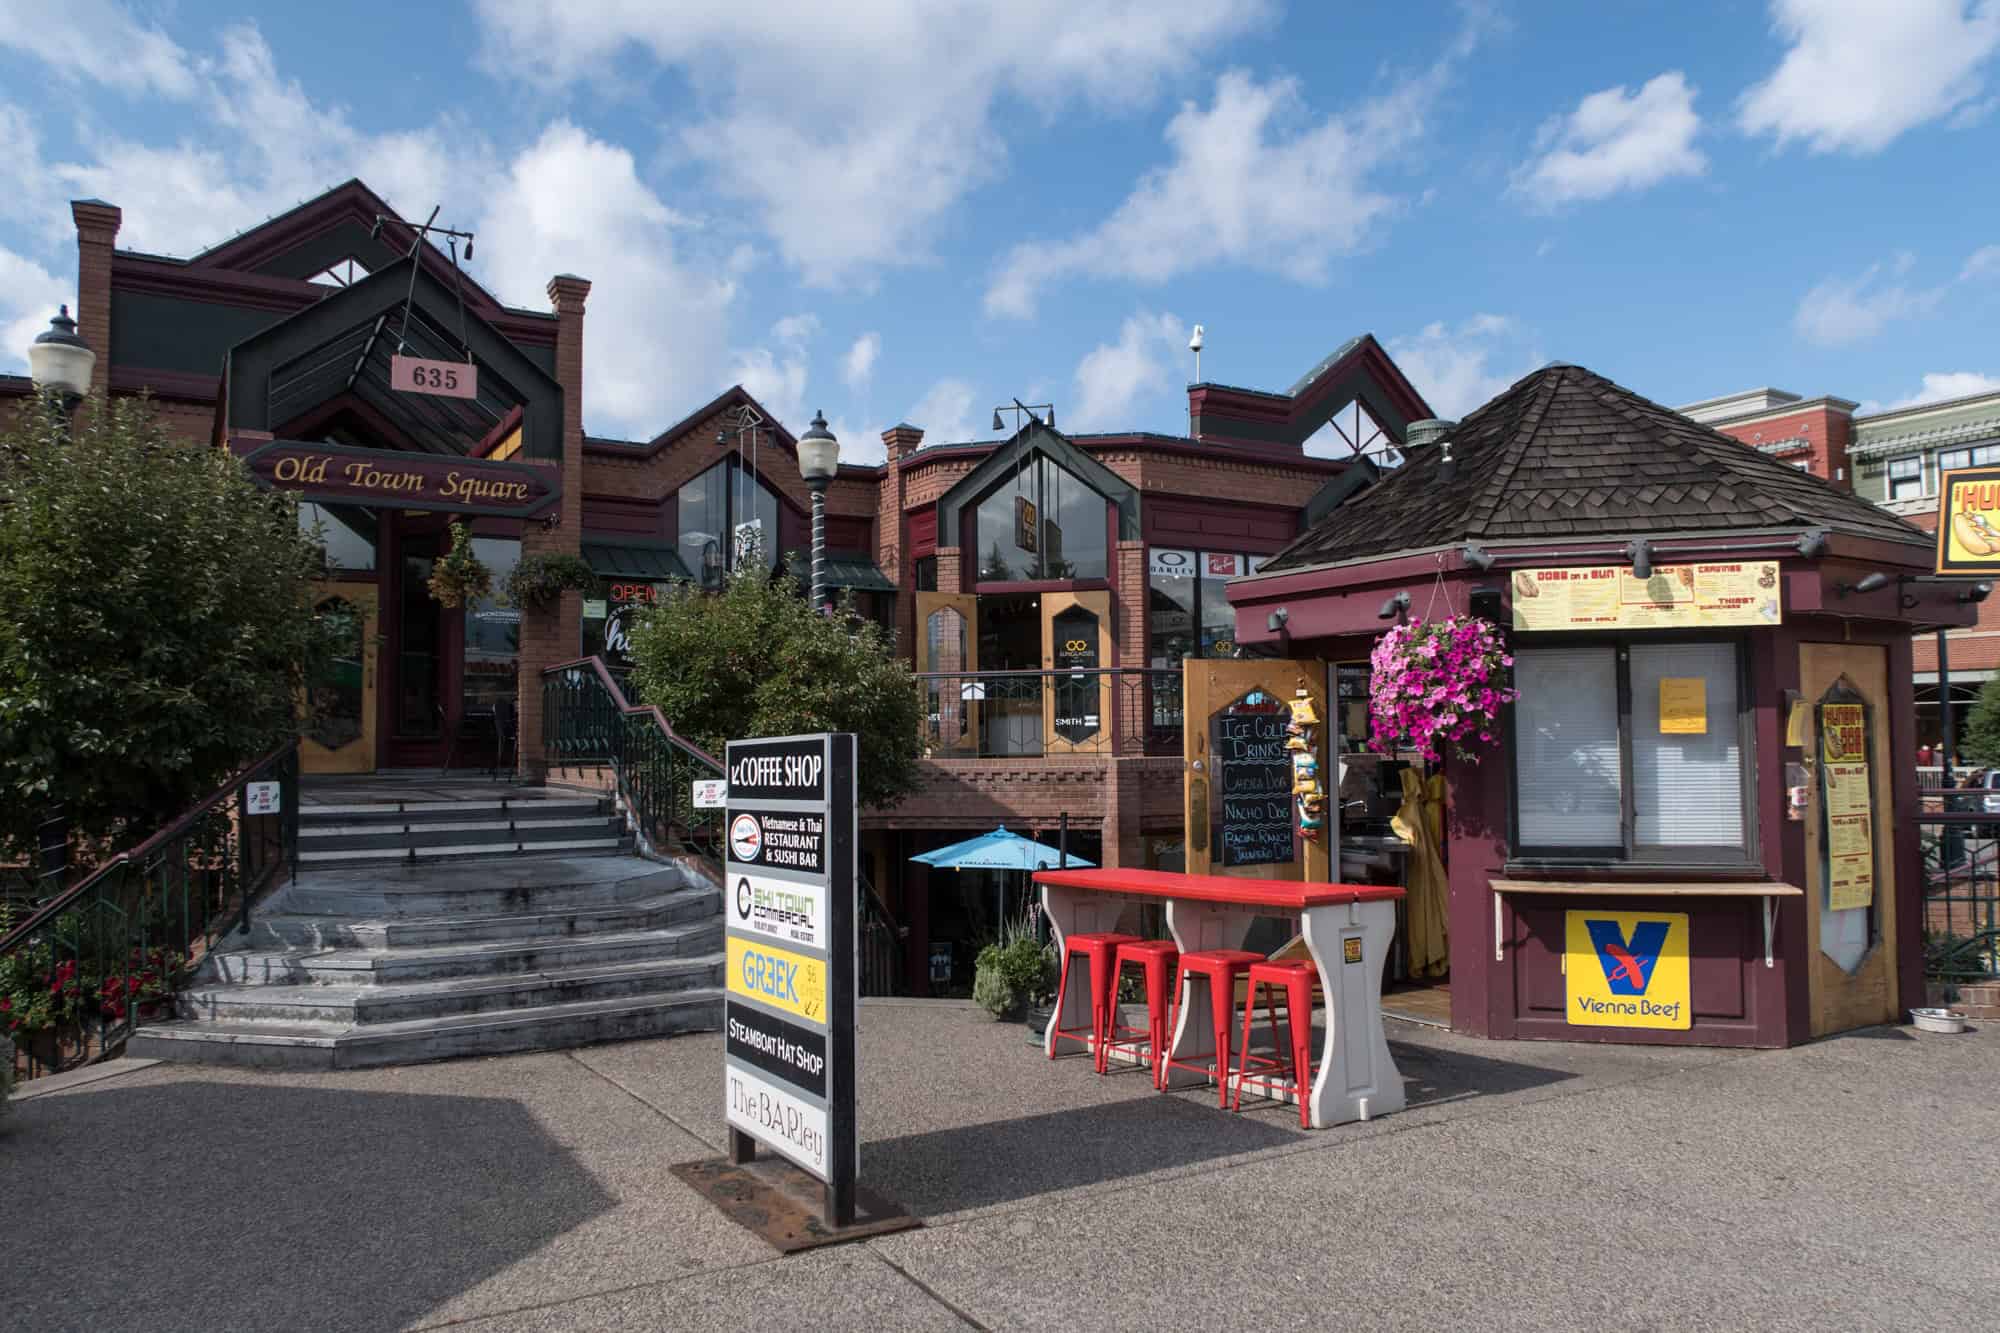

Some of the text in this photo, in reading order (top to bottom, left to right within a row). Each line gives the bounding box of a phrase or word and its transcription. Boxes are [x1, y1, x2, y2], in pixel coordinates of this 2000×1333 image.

[412, 366, 458, 390] 635
[274, 454, 530, 503] Old Town Square
[1962, 484, 2000, 511] HU
[1150, 566, 1194, 575] OAKLEY
[610, 583, 657, 603] OPEN
[1055, 718, 1082, 726] SMITH
[740, 755, 821, 787] COFFEE SHOP
[761, 815, 798, 831] Vietnamese
[799, 818, 805, 831] &
[805, 818, 822, 832] Thai
[764, 832, 819, 850] RESTAURANT
[766, 848, 817, 867] & SUSHI BAR
[754, 904, 814, 929] COMMERCIAL
[743, 950, 799, 1004] GREEK
[1578, 996, 1681, 1021] Vienna Beef
[729, 1018, 776, 1056] STEAMBOAT
[796, 1047, 823, 1076] SHOP
[730, 1077, 757, 1120] The
